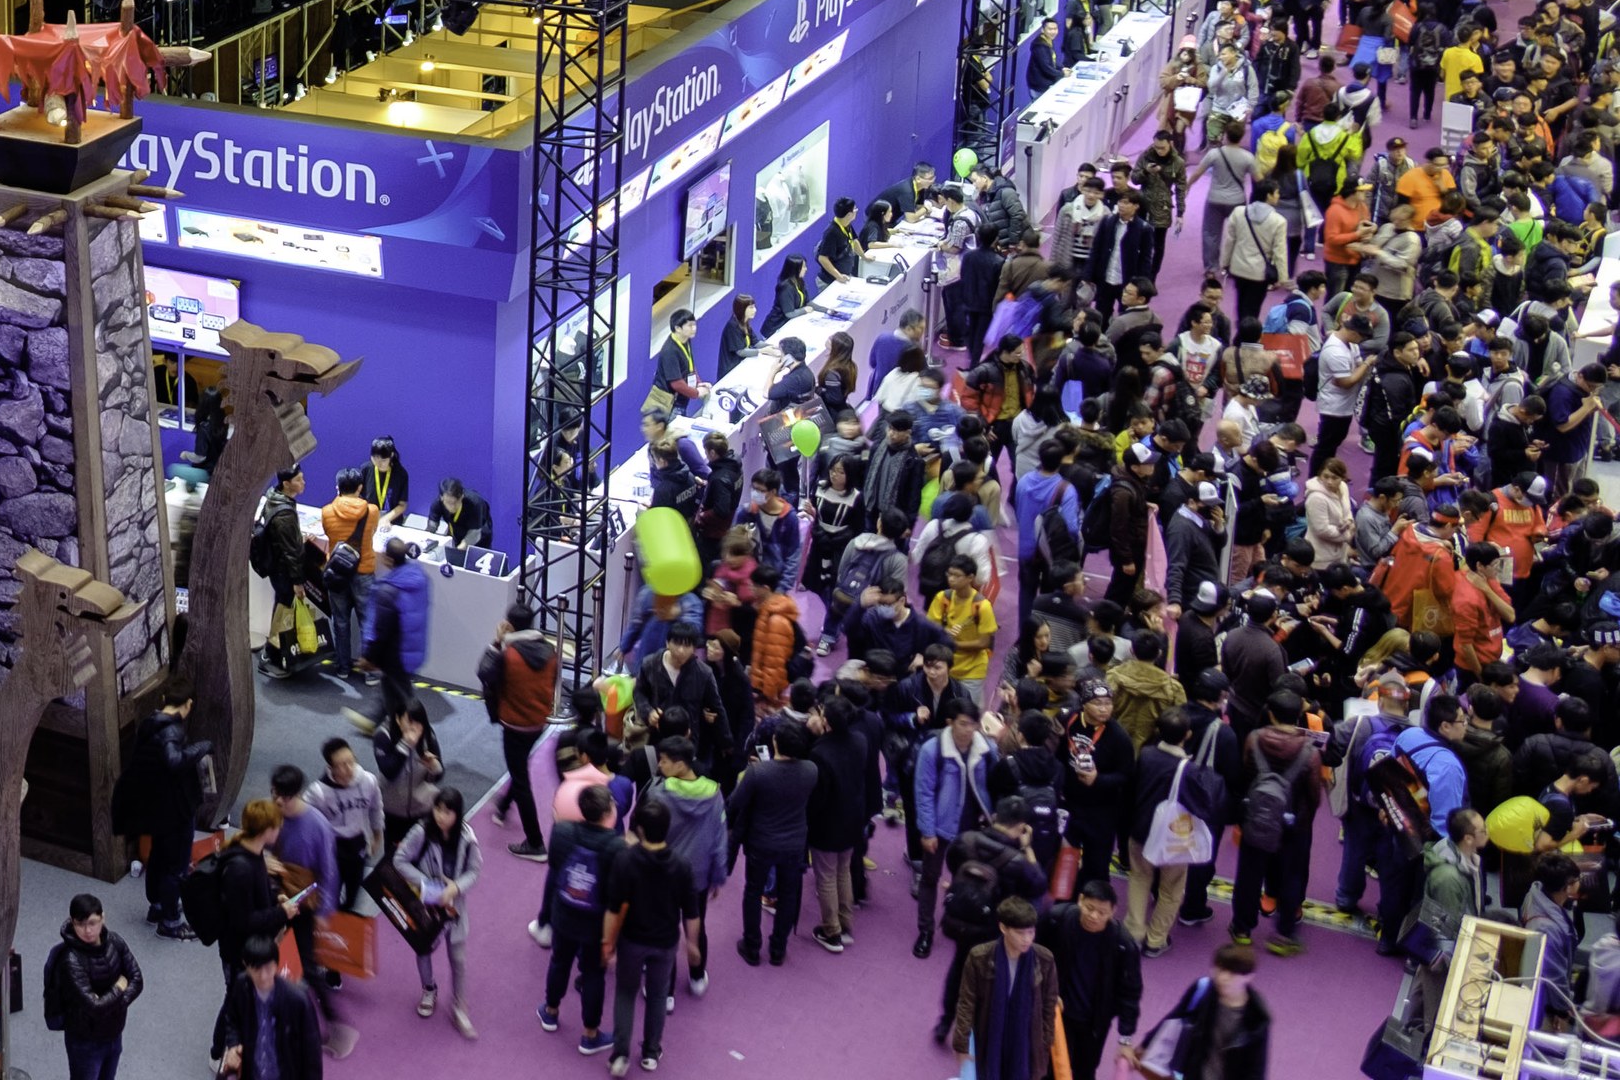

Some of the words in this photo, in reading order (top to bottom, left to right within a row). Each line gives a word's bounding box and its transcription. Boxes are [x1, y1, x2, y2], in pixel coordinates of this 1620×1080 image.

[118, 131, 377, 205] ayStation
[611, 511, 623, 535] 5
[474, 552, 495, 575] 4
